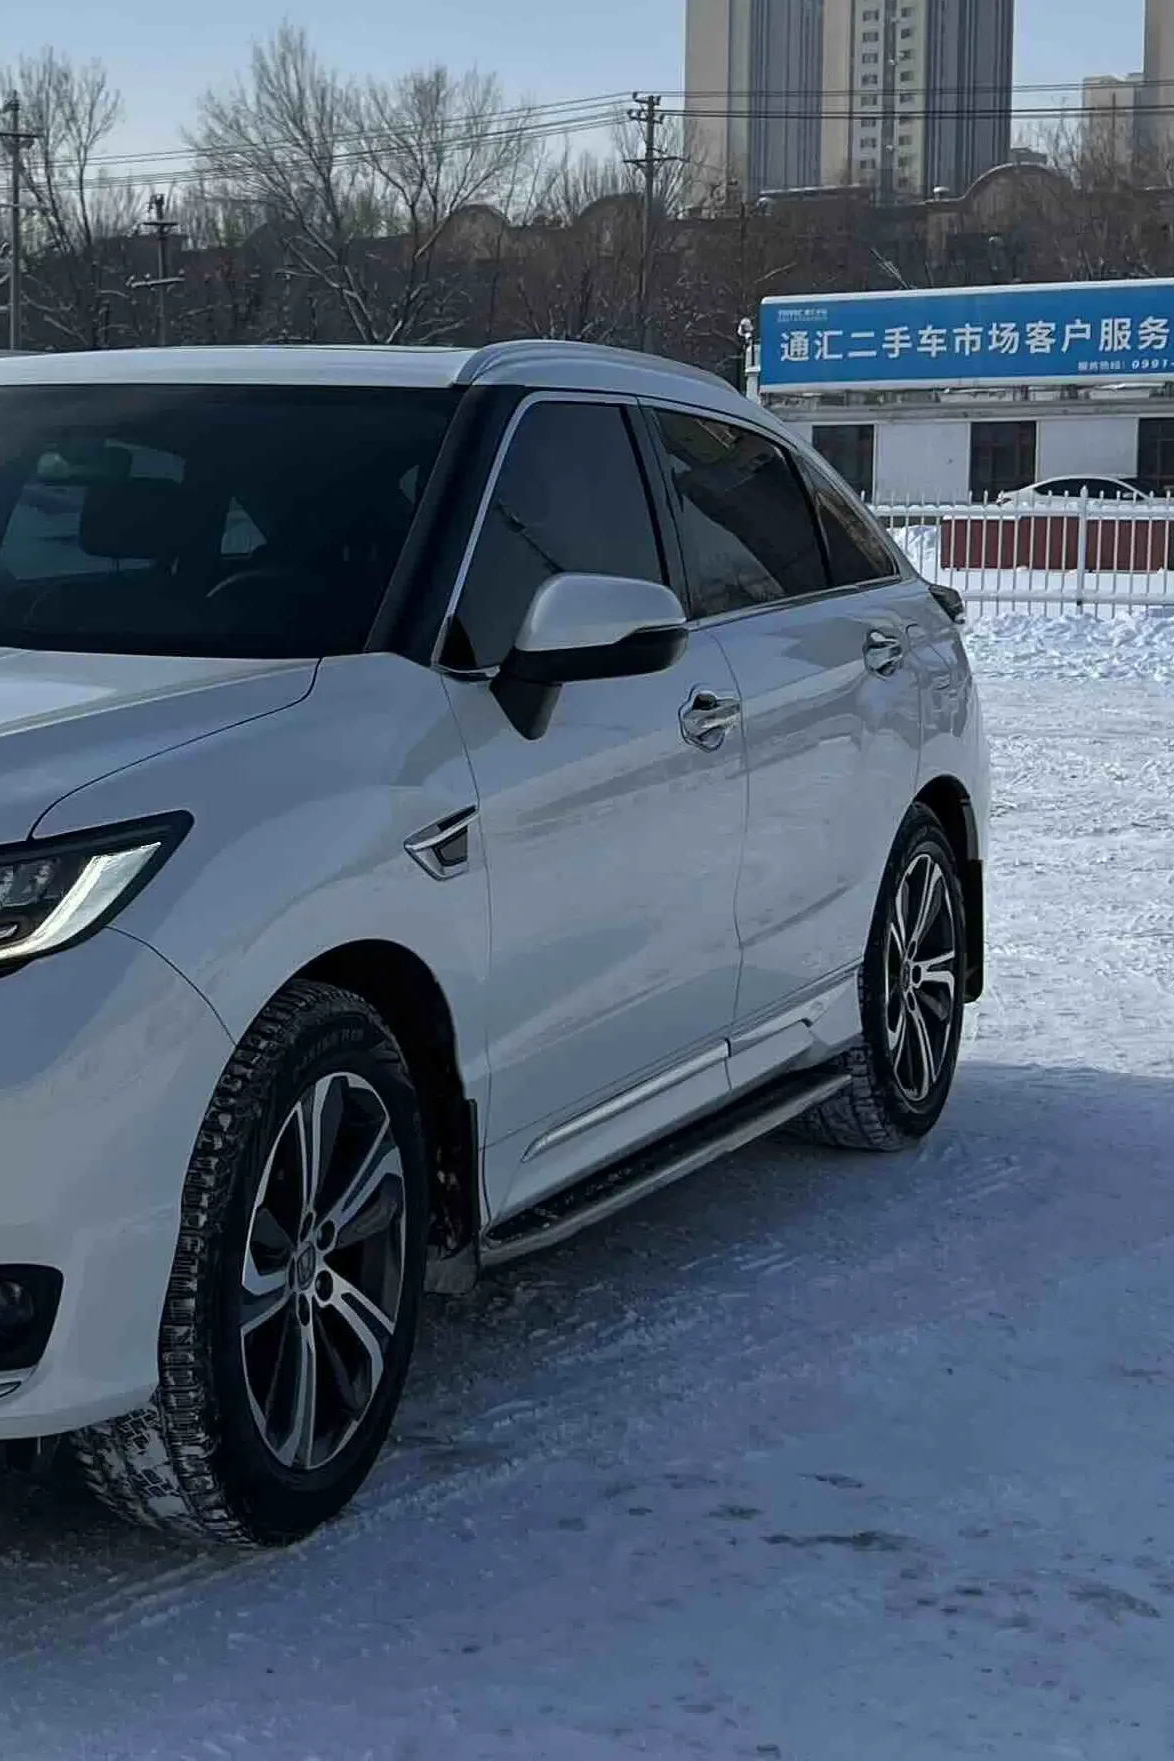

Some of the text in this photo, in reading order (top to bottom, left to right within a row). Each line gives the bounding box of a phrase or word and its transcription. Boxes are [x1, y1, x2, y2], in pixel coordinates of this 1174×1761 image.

[779, 316, 1171, 363] 通汇二手车市场客户服务
